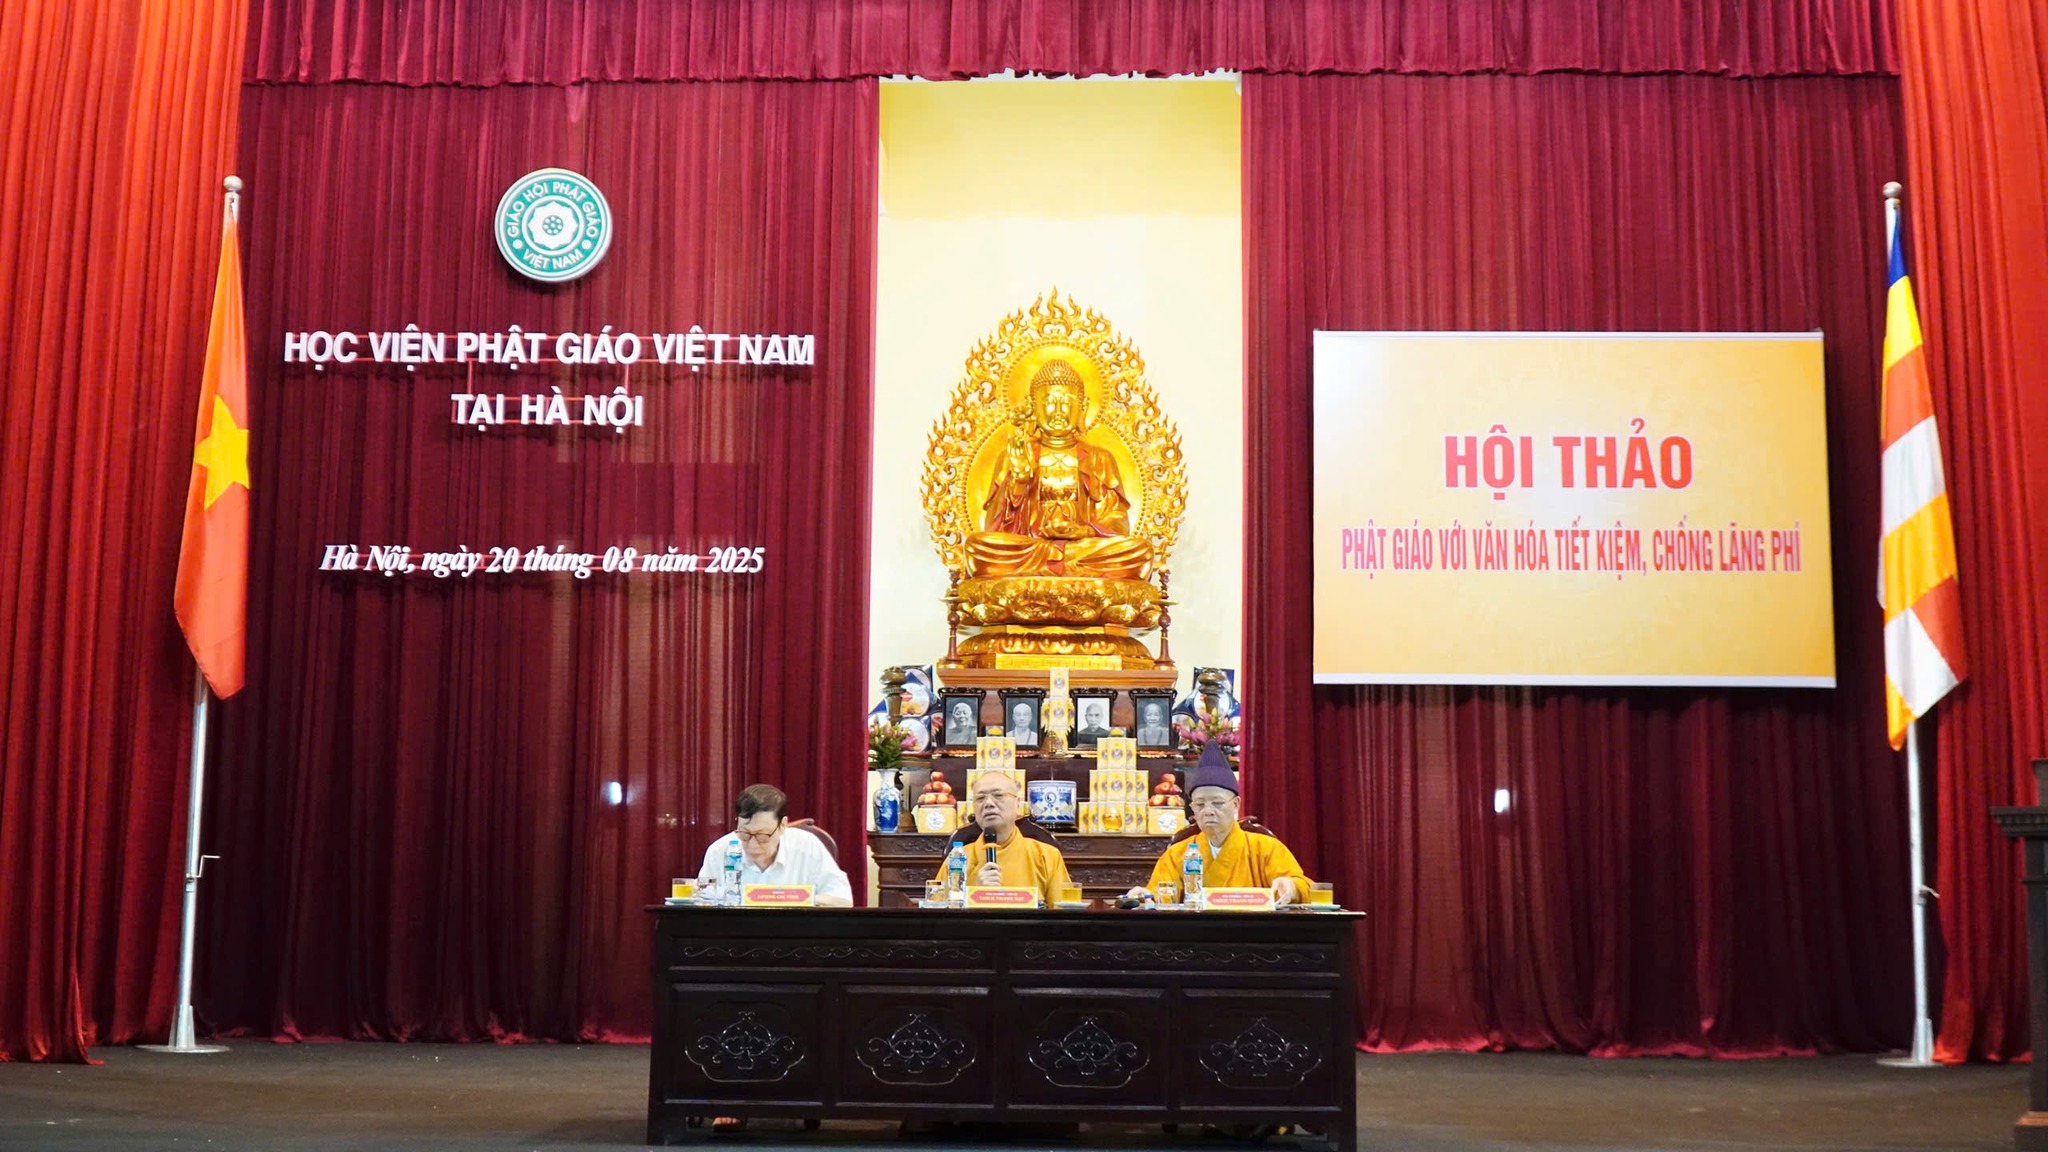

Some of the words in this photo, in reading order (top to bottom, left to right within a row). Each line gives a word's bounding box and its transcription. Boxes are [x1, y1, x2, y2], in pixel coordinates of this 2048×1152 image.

[506, 201, 525, 237] GIÁO
[523, 183, 549, 202] HỘI
[553, 181, 586, 201] PHẬT
[582, 202, 601, 238] GIÁO
[523, 249, 551, 269] VIỆT
[553, 249, 584, 269] NAM
[285, 331, 358, 370] HỌC
[368, 323, 446, 372] VIỆN
[457, 324, 547, 370] PHẬT
[556, 325, 642, 366] GIÁO
[653, 325, 730, 372] VIỆT
[738, 334, 815, 366] NAM
[451, 393, 505, 432] TẠI
[520, 385, 571, 426] HÀ
[584, 385, 644, 433] NỘI
[1445, 425, 1533, 500] HỘI
[1553, 418, 1693, 489] THẢO
[319, 544, 358, 571] Hà
[363, 544, 415, 577] Nội,
[421, 545, 481, 578] ngày
[485, 547, 519, 573] 20
[523, 545, 594, 578] tháng
[602, 547, 633, 574] 08
[641, 546, 697, 573] năm
[704, 546, 765, 574] 2025
[1342, 519, 1386, 579] PHẬT
[1392, 519, 1433, 570] GIÁO
[1439, 519, 1467, 570] VỚI
[1473, 520, 1508, 570] VĂN
[1515, 519, 1549, 570] HÓA
[1555, 515, 1590, 571] TIẾT
[1597, 520, 1647, 580] KIỆM,
[1653, 514, 1713, 571] CHỐNG
[1719, 521, 1766, 571] LÃNG
